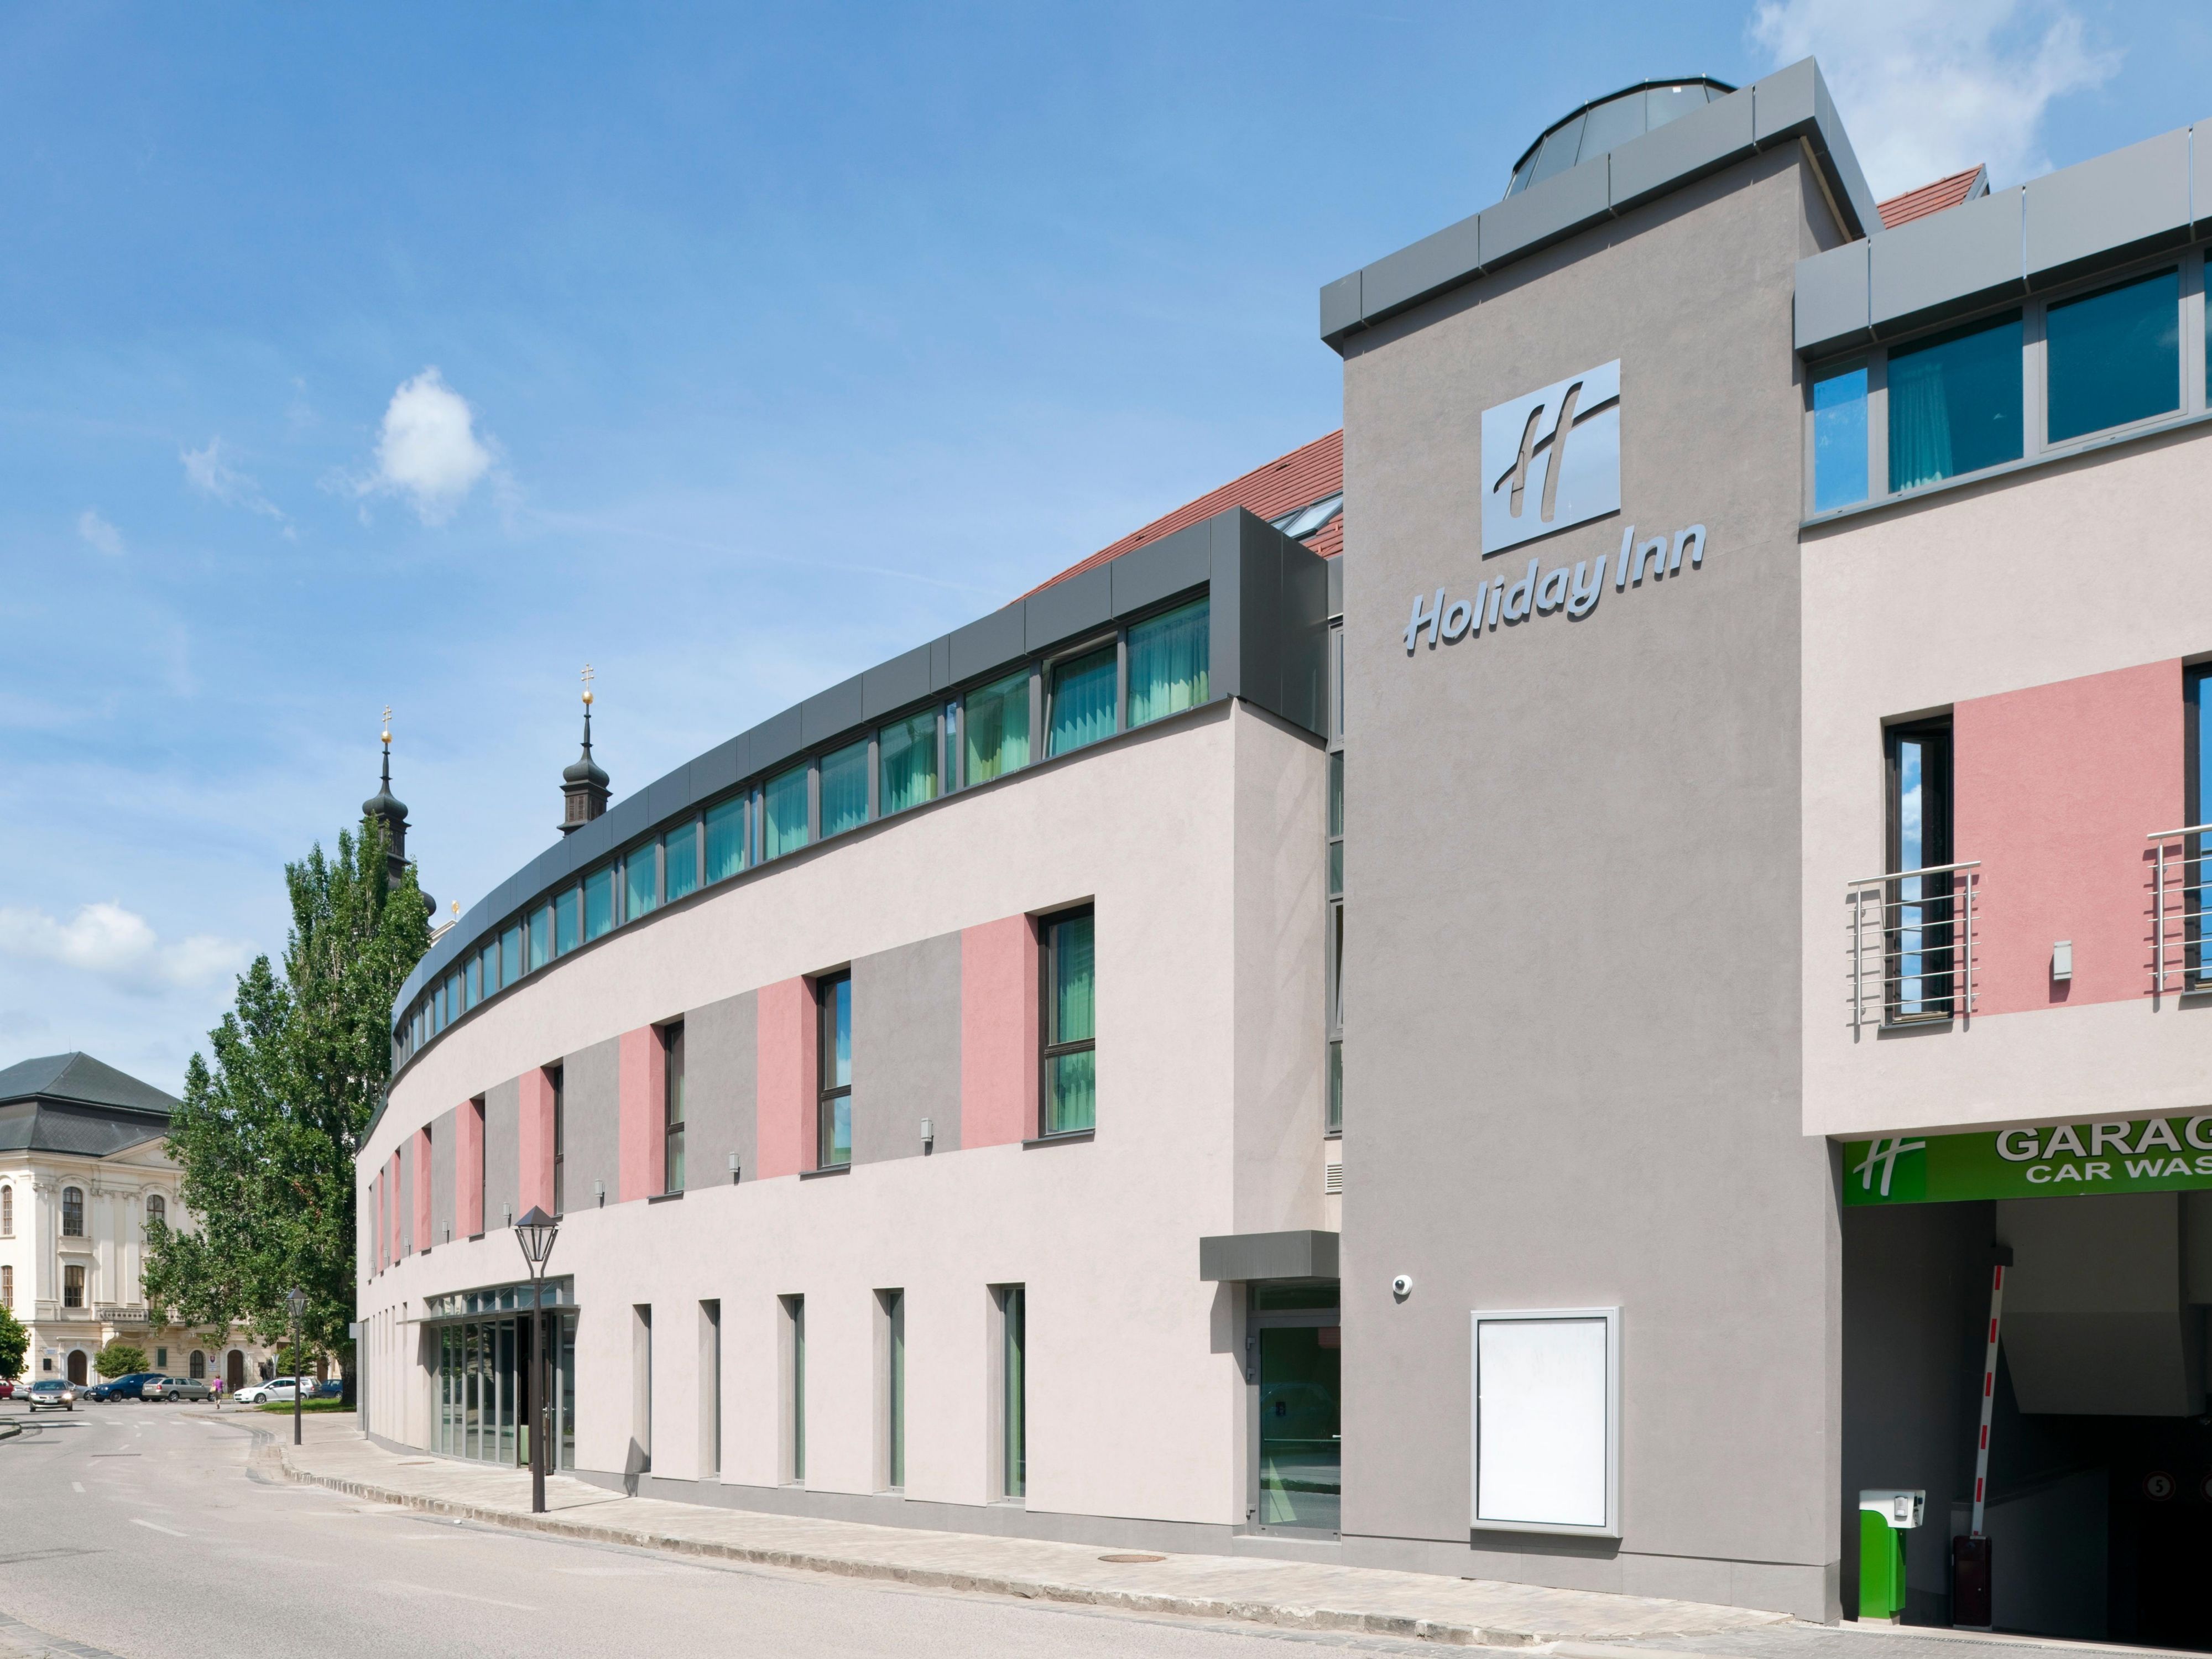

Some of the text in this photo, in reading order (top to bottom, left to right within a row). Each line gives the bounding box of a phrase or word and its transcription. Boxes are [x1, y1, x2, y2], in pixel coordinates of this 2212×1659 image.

[1403, 524, 1707, 650] Holiday Inn
[2026, 1162, 2112, 1183] CAR
[2156, 1479, 2164, 1493] 5
